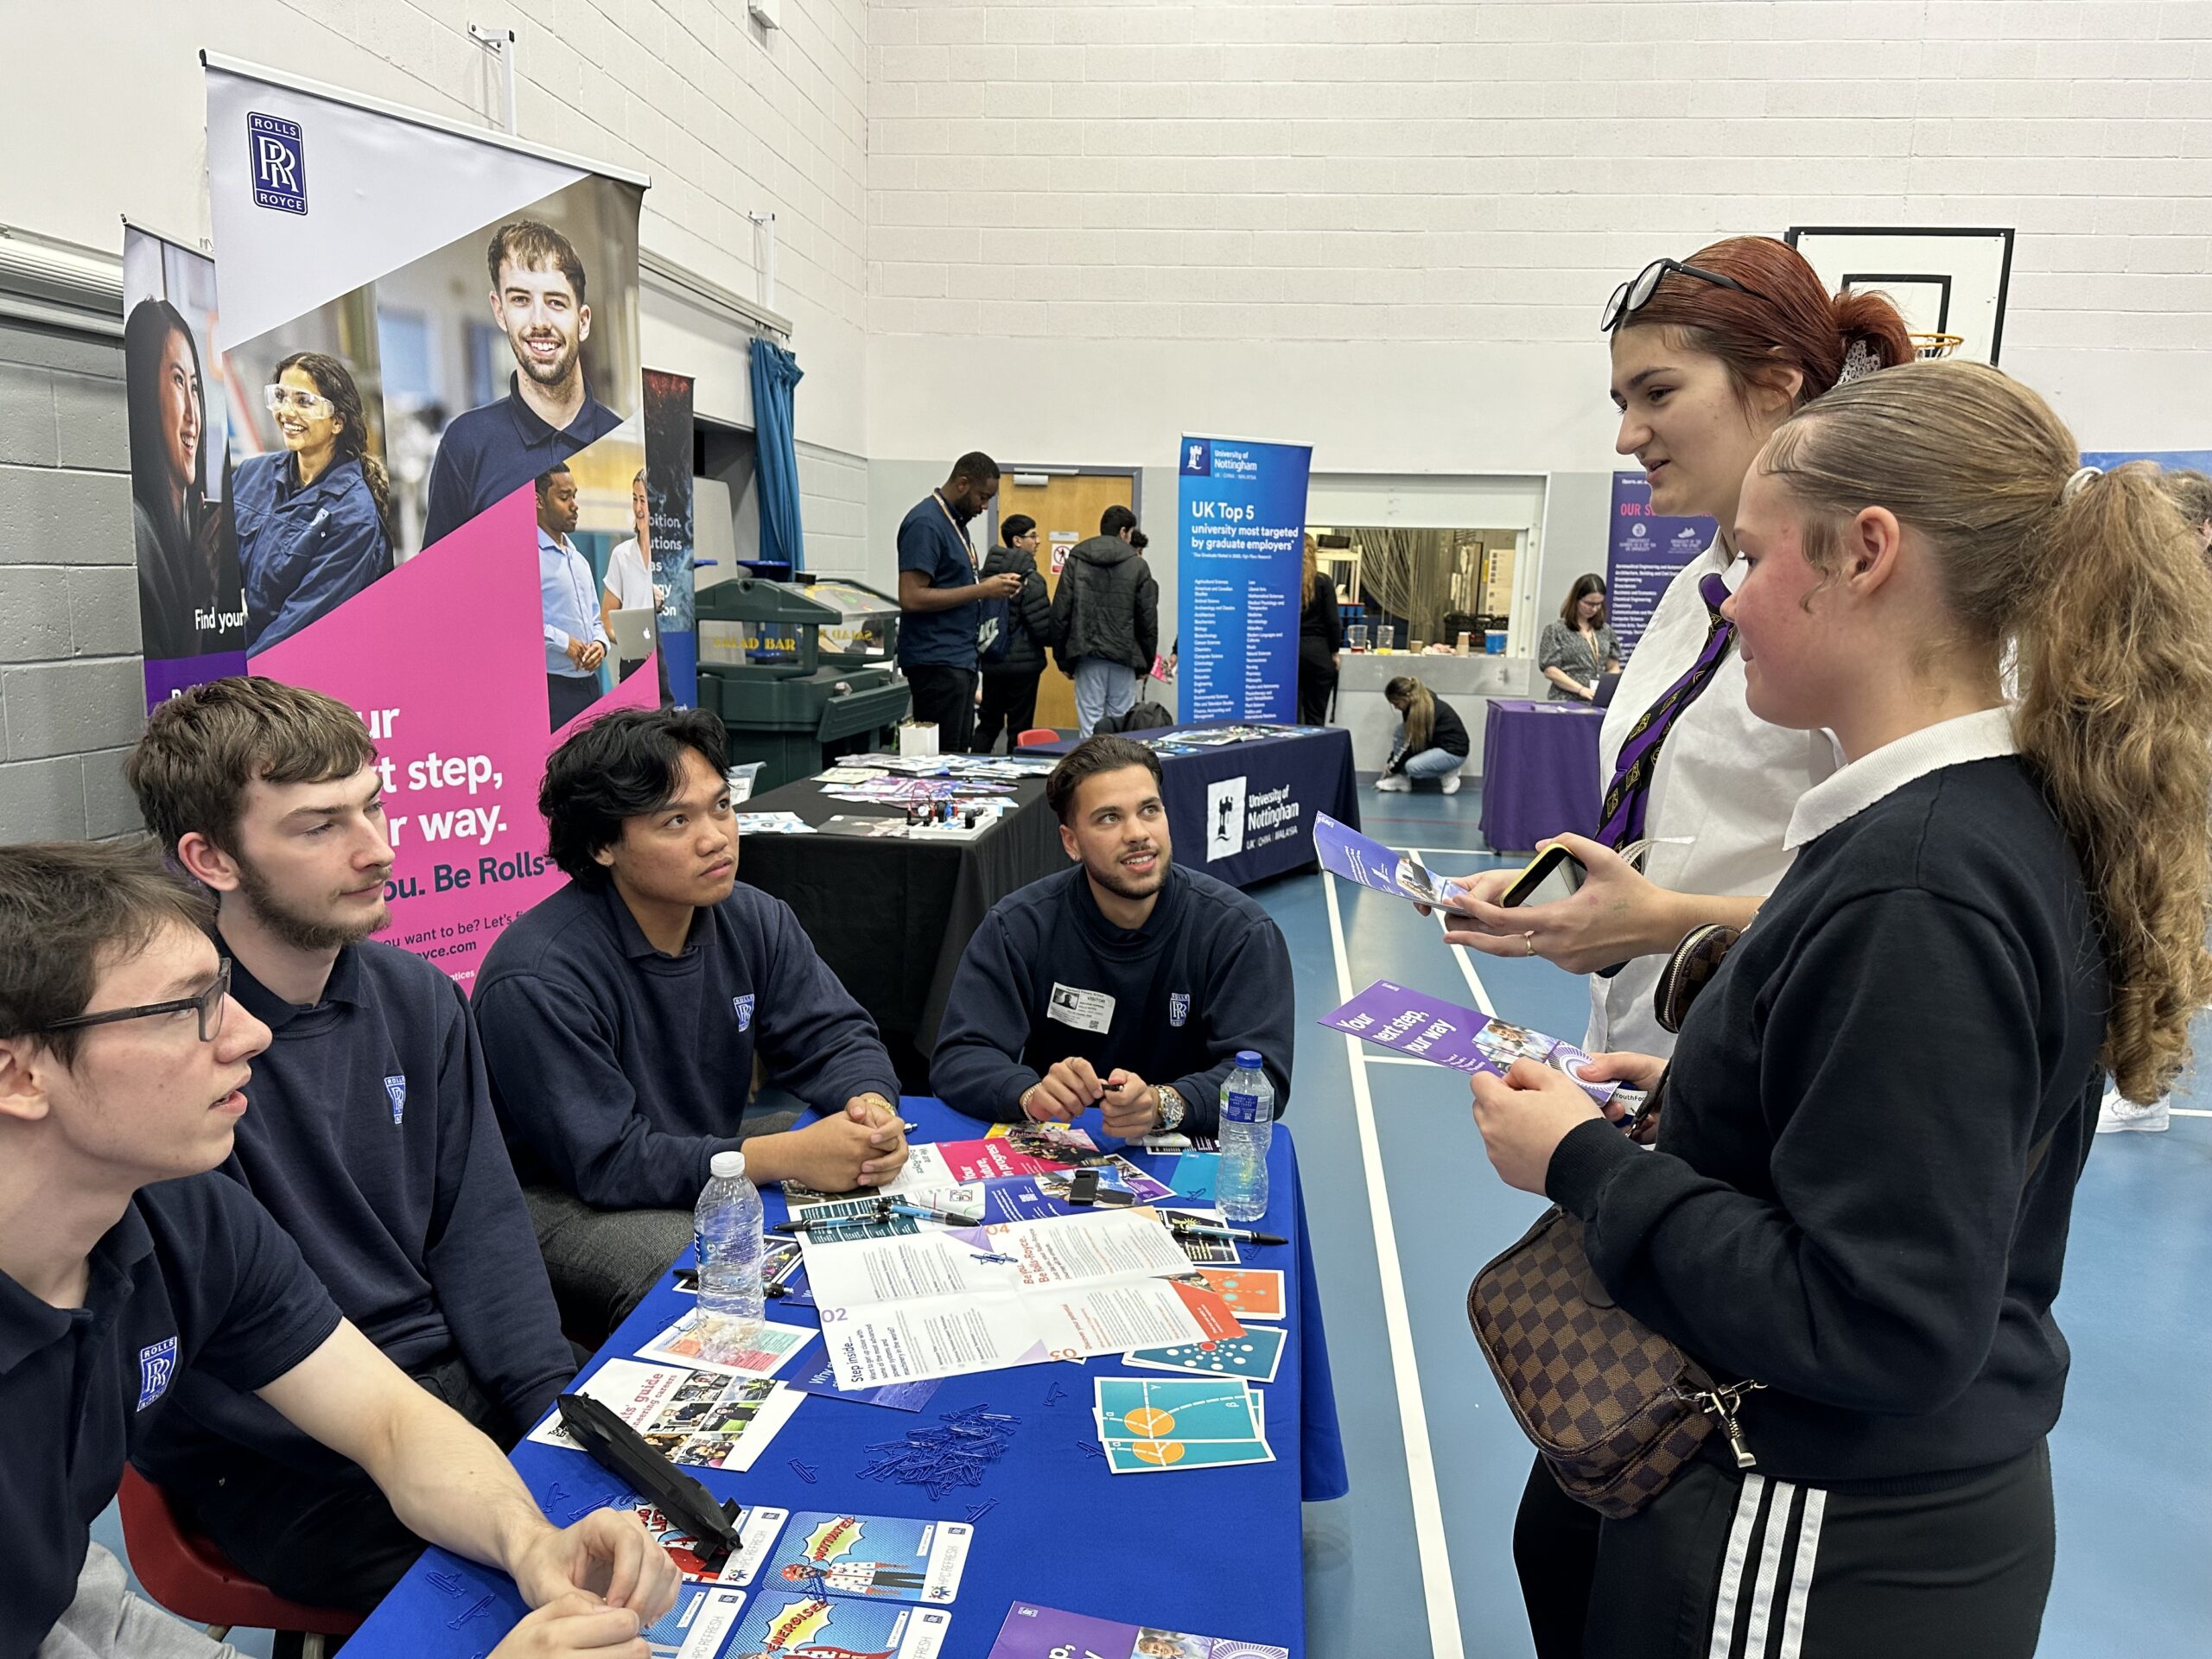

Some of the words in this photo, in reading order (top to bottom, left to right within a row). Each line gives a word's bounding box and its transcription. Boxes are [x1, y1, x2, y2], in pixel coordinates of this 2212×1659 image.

[254, 118, 296, 137] ROLLS
[257, 135, 300, 193] RR
[260, 193, 302, 210] ROYCE
[1214, 449, 1242, 460] University
[1214, 459, 1257, 472] Nottingham
[1192, 501, 1215, 518] UK
[1217, 503, 1243, 523] Top
[1245, 505, 1255, 519] 5
[1620, 503, 1641, 516] OUR
[1191, 523, 1236, 537] university
[1238, 527, 1259, 537] most
[1262, 527, 1299, 539] targeted
[1191, 537, 1203, 550] by
[1205, 539, 1245, 550] graduate
[194, 607, 216, 631] Find
[218, 612, 244, 634] your
[714, 637, 759, 651] SALAD
[765, 638, 795, 652] BAR
[408, 752, 503, 795] step,
[1249, 788, 1281, 809] University
[1281, 784, 1290, 798] of
[418, 804, 507, 846] way.
[1248, 802, 1300, 831] Nottingham
[434, 864, 471, 893] Be
[404, 929, 436, 945] want
[441, 926, 454, 938] to
[458, 918, 480, 935] be?
[484, 913, 512, 930] Let's
[1337, 1013, 1376, 1031] Your
[1372, 1024, 1398, 1043] next
[1392, 1009, 1430, 1031] step,
[1425, 1018, 1457, 1041] way
[985, 1143, 1014, 1173] progress
[985, 1223, 1010, 1236] 04
[1023, 1274, 1034, 1284] Be
[1039, 1272, 1050, 1283] Be
[821, 1307, 848, 1323] 02
[144, 1338, 174, 1358] ROLLS
[809, 1368, 834, 1383] Why
[851, 1365, 863, 1382] Step
[868, 1369, 877, 1380] Want
[634, 1373, 664, 1402] guide
[654, 1374, 677, 1398] careers
[813, 1516, 855, 1561] MOTIVATED
[941, 1546, 959, 1572] REFRESH
[938, 1572, 951, 1586] HPC
[698, 1616, 724, 1646] REFRESH
[767, 1599, 829, 1652] ENERGISED
